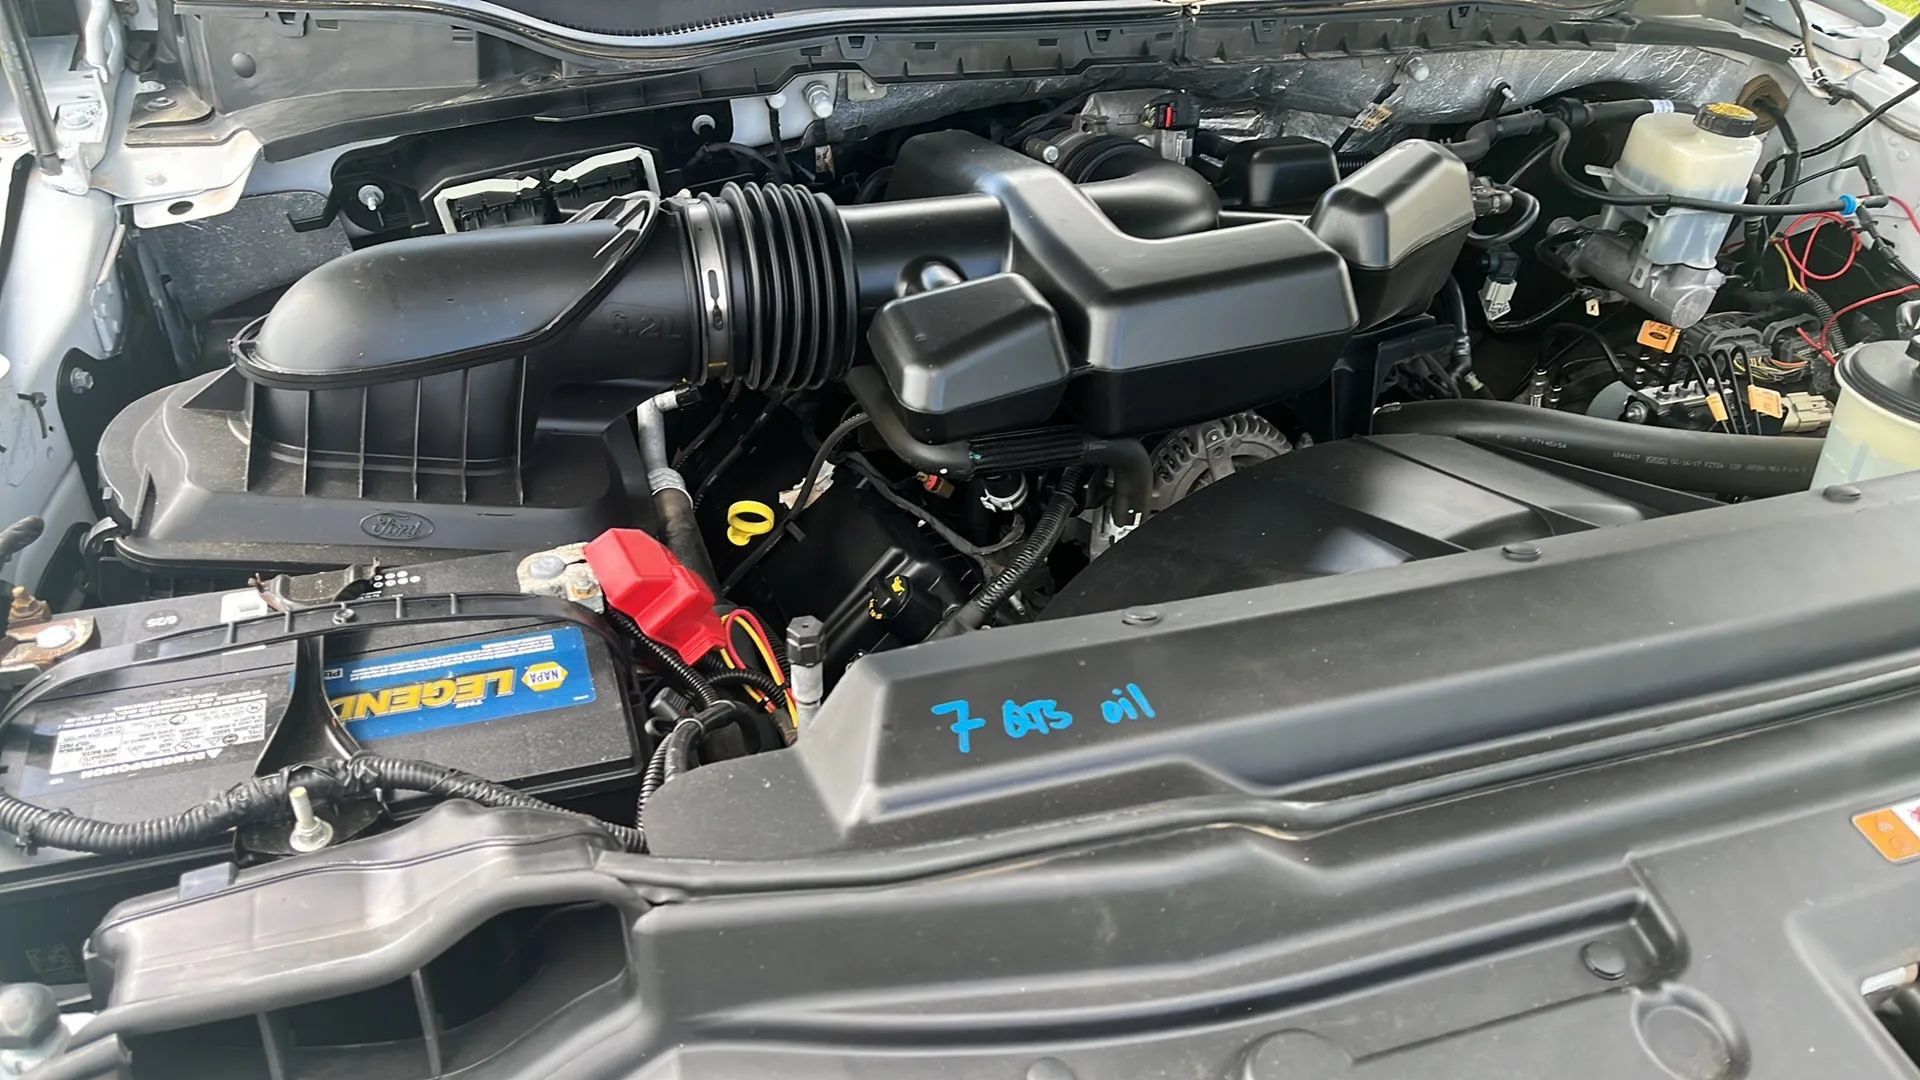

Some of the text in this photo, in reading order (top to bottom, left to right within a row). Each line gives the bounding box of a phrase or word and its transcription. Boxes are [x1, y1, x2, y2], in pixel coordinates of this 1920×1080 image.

[608, 309, 683, 339] 6.2L
[370, 510, 425, 538] Ford
[529, 668, 560, 683] NAPA
[931, 699, 986, 753] 7
[1101, 682, 1155, 724] oil
